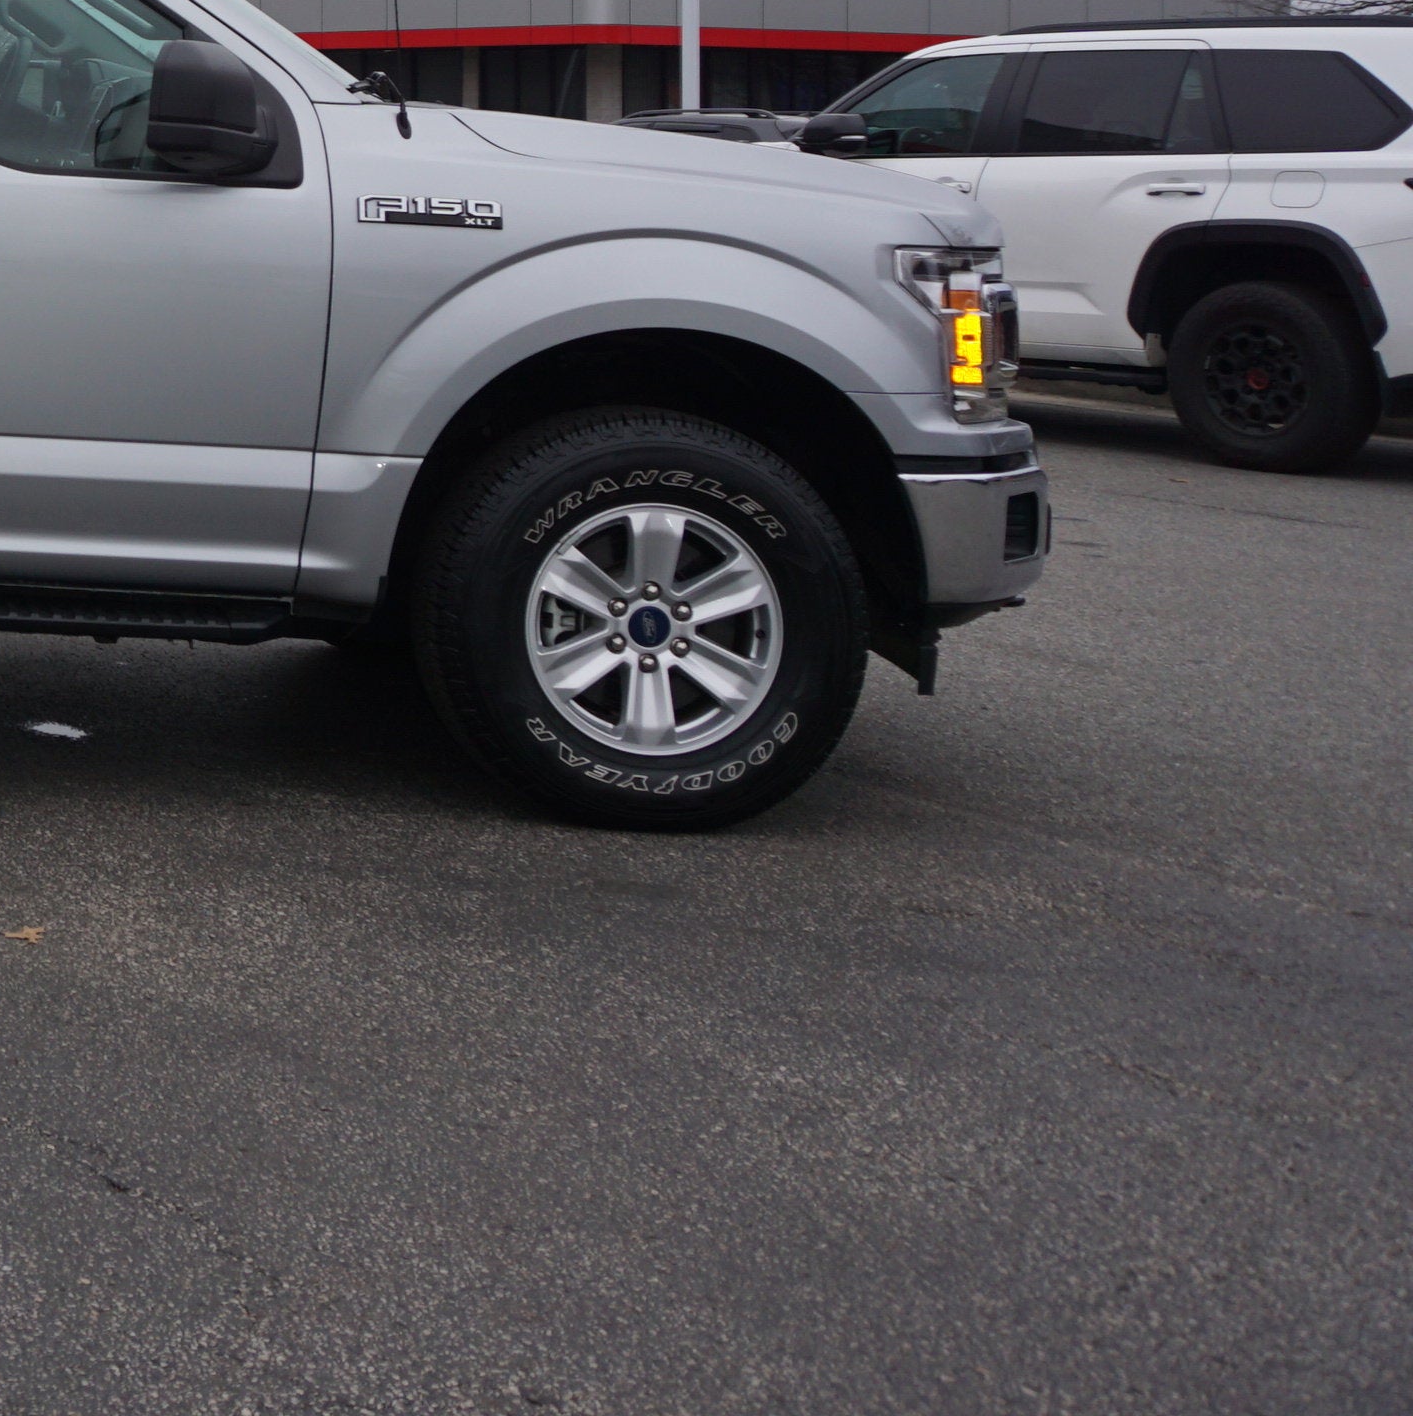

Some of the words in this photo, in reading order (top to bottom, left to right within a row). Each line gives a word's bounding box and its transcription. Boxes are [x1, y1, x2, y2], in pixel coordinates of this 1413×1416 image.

[464, 217, 496, 226] XLT
[524, 468, 789, 545] WRANGLER
[526, 711, 800, 796] GOODYEAR
